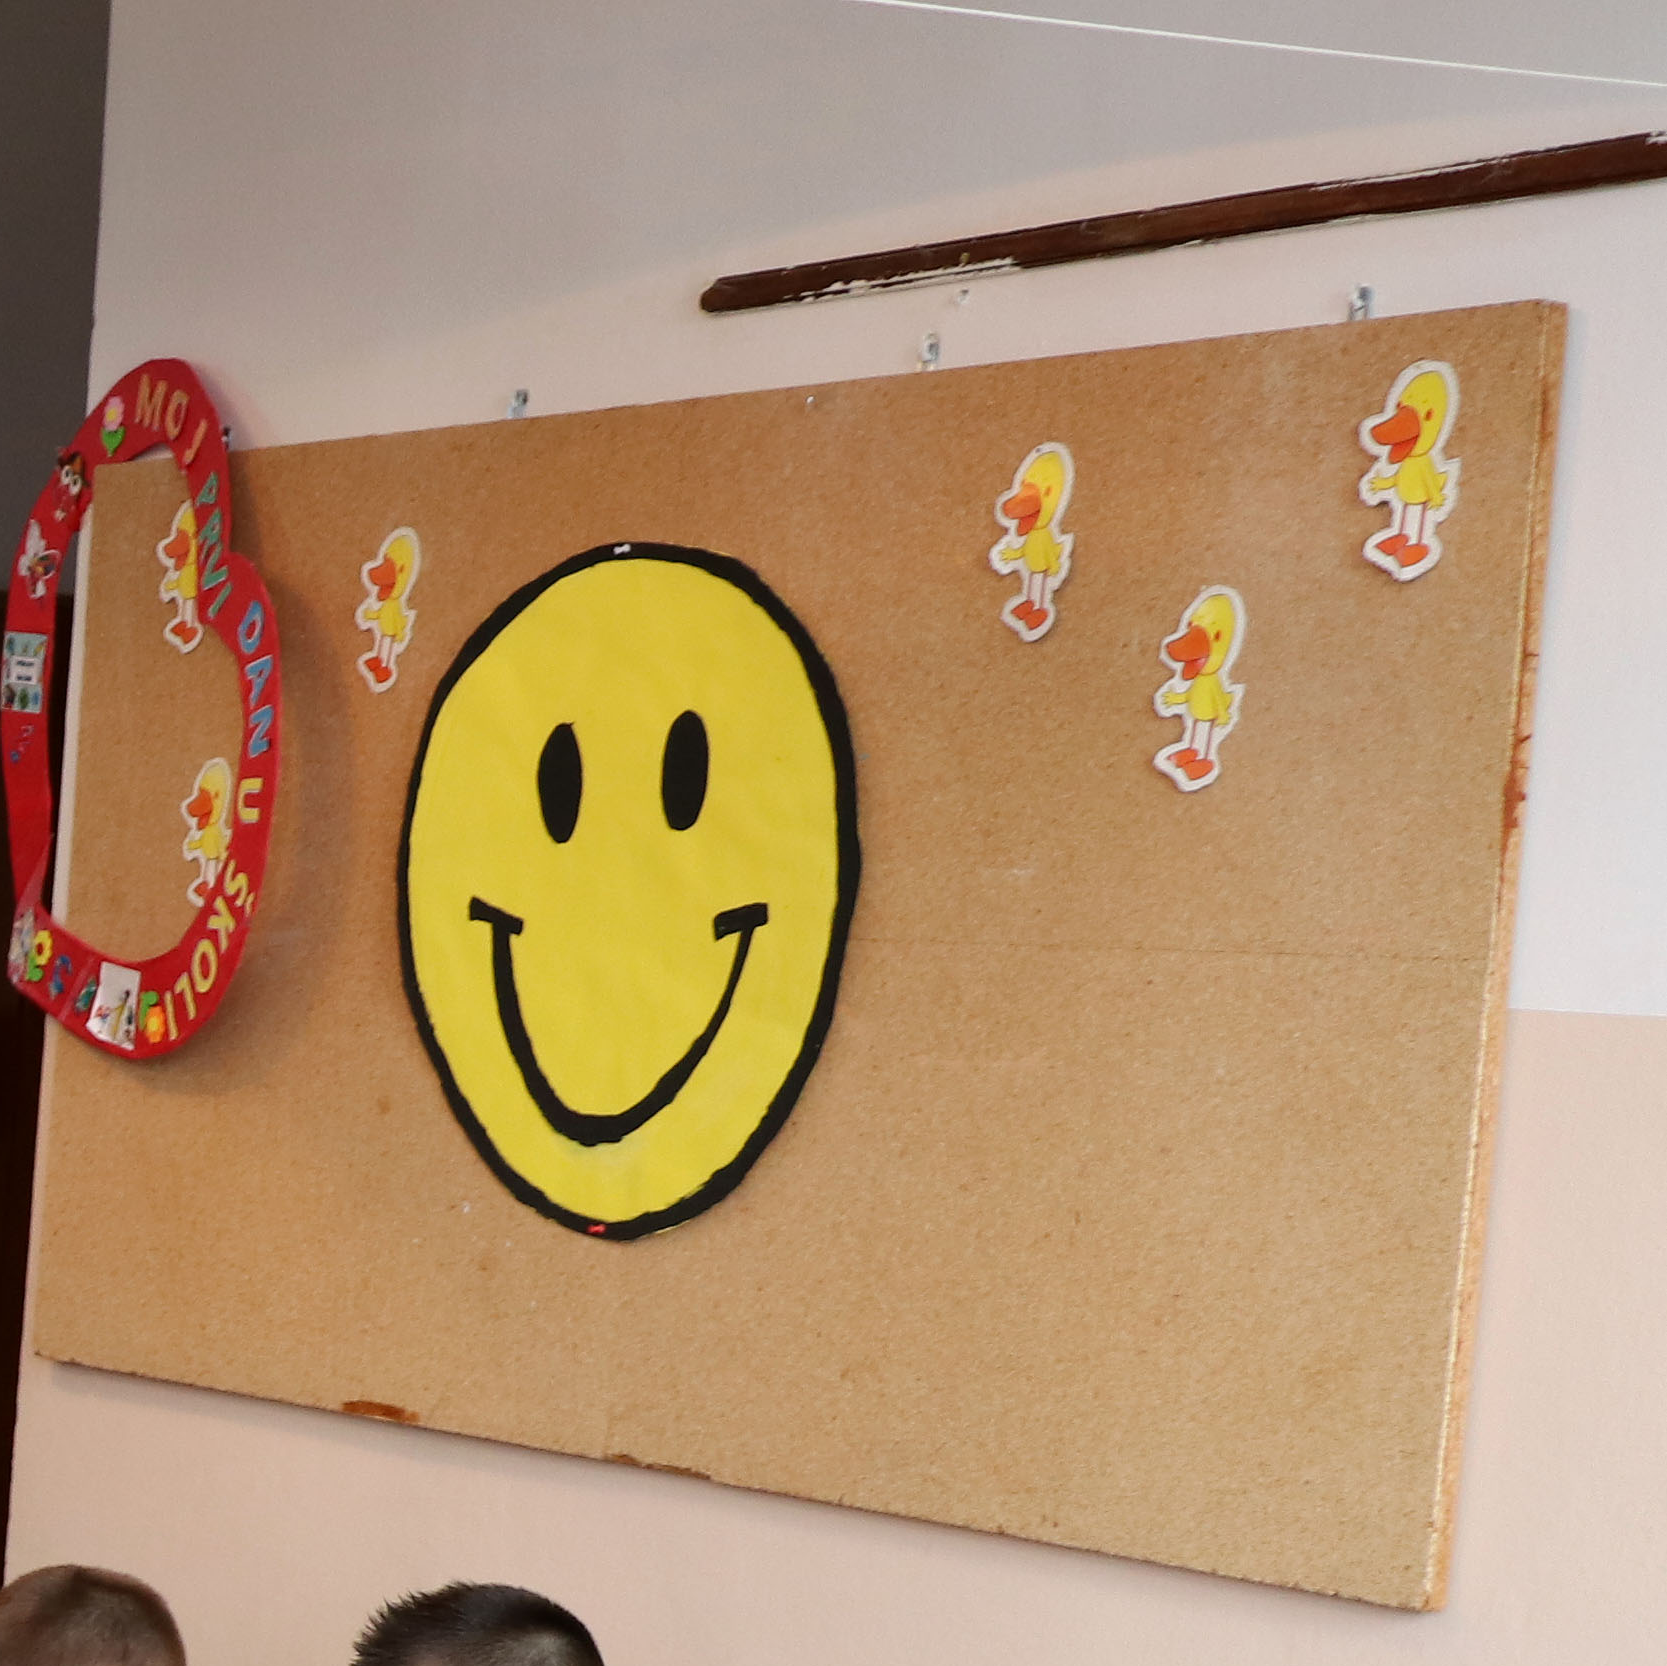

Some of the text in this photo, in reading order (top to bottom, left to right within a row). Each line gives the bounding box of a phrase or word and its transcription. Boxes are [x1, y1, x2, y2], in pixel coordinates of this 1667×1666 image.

[134, 372, 208, 466] MOJ
[237, 600, 275, 758] DAN
[238, 777, 263, 823] U
